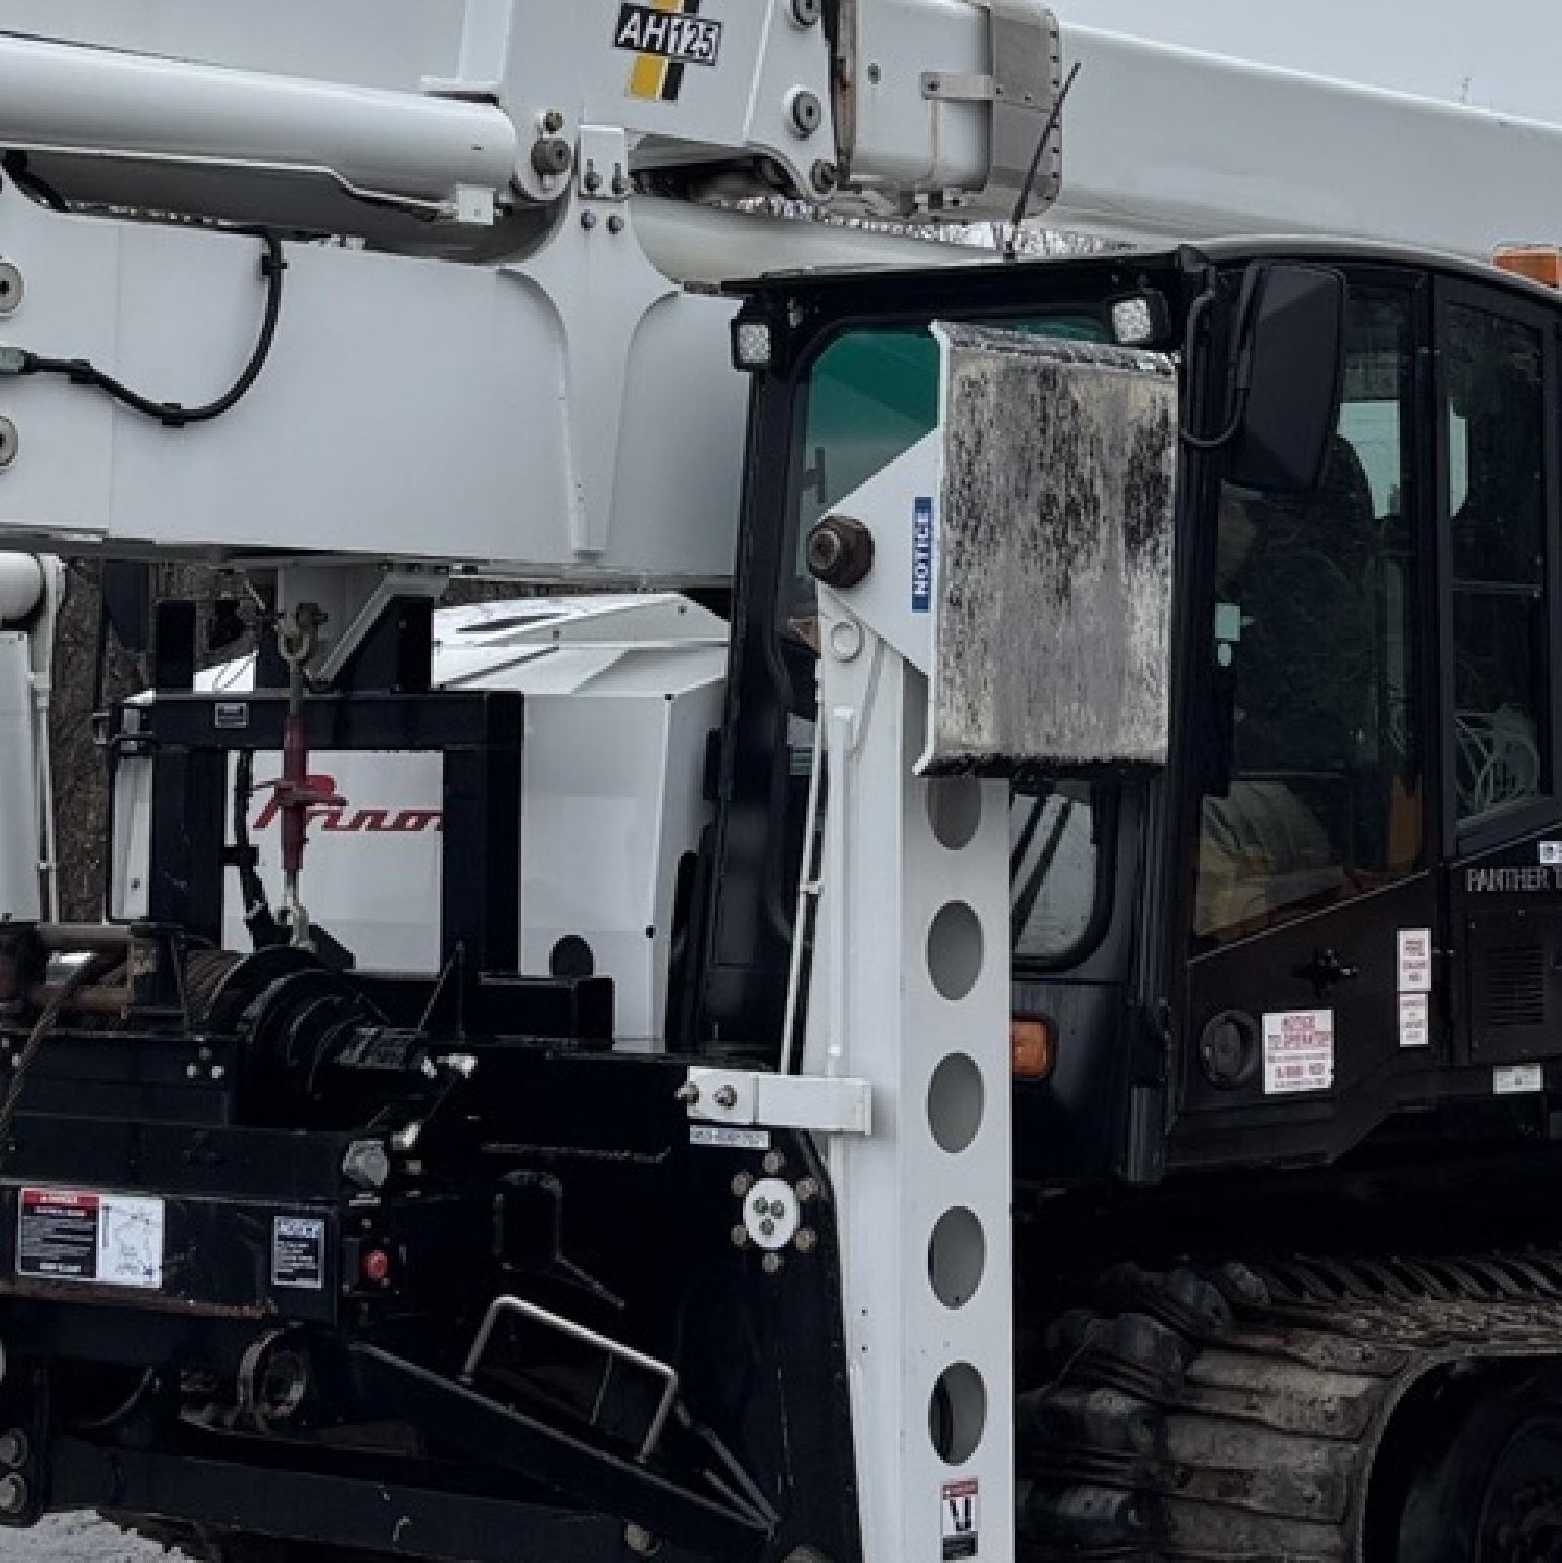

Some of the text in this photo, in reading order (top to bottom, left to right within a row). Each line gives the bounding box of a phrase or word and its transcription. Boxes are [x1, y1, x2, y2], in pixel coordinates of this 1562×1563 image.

[617, 12, 719, 60] AH125
[914, 512, 930, 595] NOTICE
[1466, 867, 1551, 891] PANTHER
